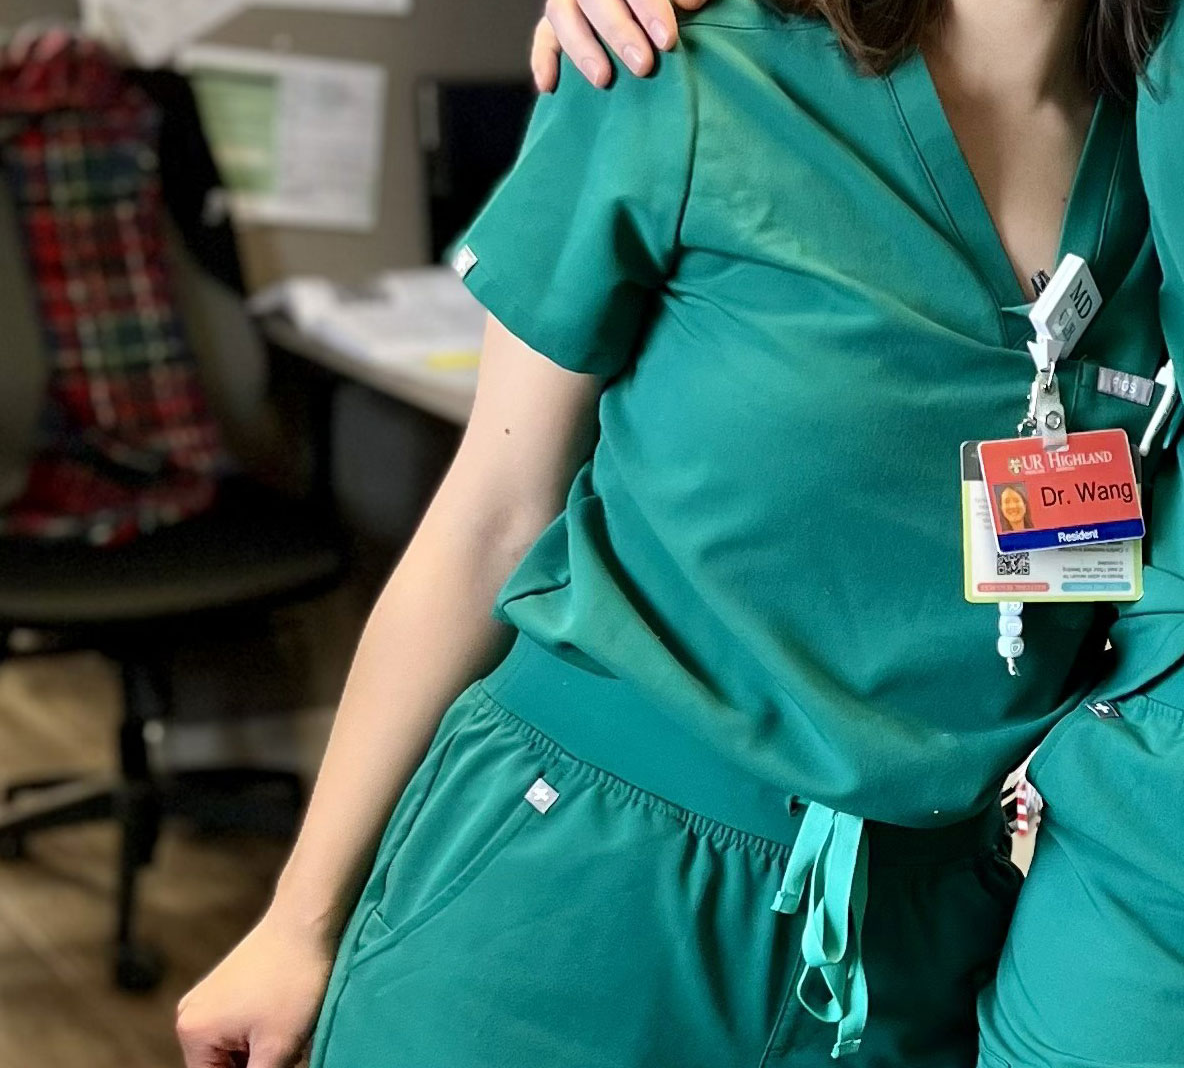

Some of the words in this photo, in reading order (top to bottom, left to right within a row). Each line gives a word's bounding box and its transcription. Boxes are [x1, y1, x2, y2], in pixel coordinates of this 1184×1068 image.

[1069, 278, 1093, 320] MD
[1022, 453, 1045, 471] UR
[1048, 451, 1112, 469] HIGHLAND
[1041, 486, 1070, 507] Dr.
[1075, 482, 1133, 504] Wang
[1058, 529, 1098, 543] Resident
